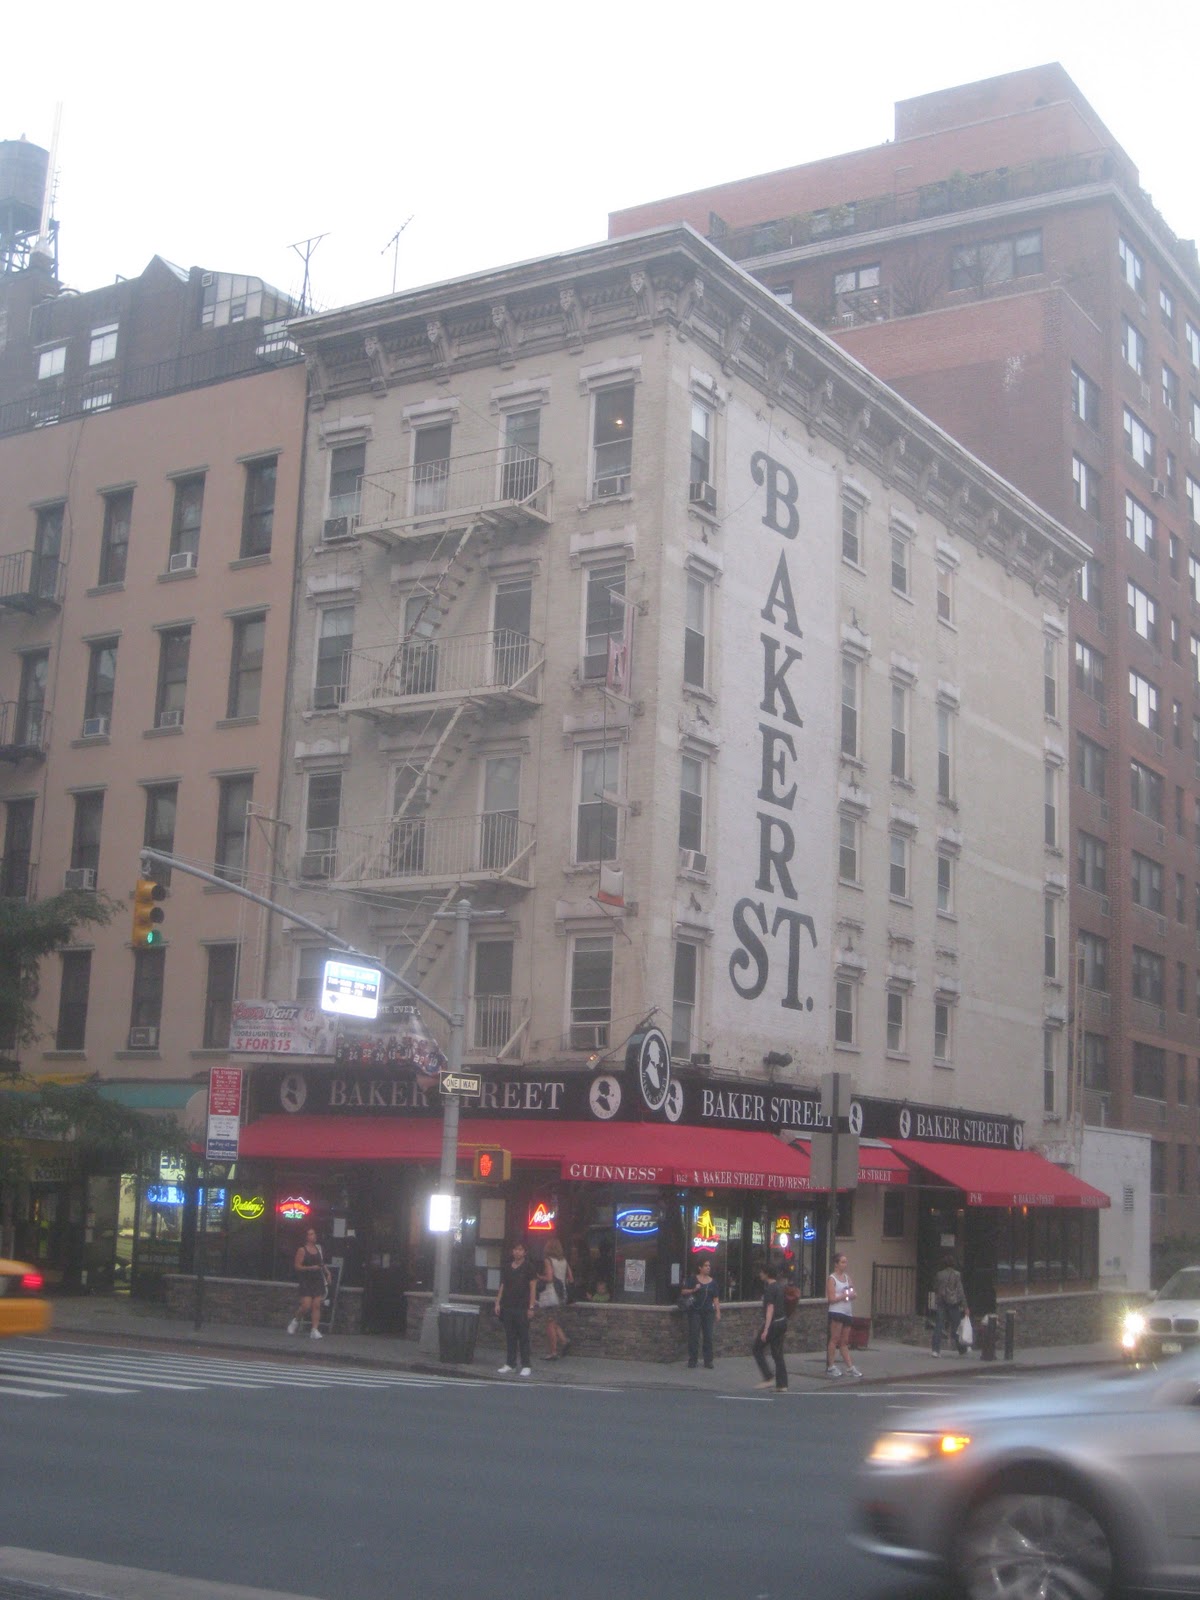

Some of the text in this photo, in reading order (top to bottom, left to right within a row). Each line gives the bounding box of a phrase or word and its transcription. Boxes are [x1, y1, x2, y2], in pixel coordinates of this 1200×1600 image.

[750, 450, 804, 901] BAKER
[265, 1007, 297, 1020] LIGHT
[236, 1038, 243, 1049] 5
[245, 1038, 268, 1050] FOR
[446, 1078, 476, 1090] ONE WAY
[328, 1079, 430, 1107] BAKER
[441, 1080, 565, 1110] REET
[702, 1089, 765, 1122] BAKER
[917, 1114, 1009, 1146] BAKER STREET
[569, 1163, 658, 1182] GUINNESS
[702, 1171, 732, 1185] BAKER
[733, 1172, 765, 1187] STREET
[867, 1169, 892, 1182] STREET
[625, 1214, 652, 1222] BUD
